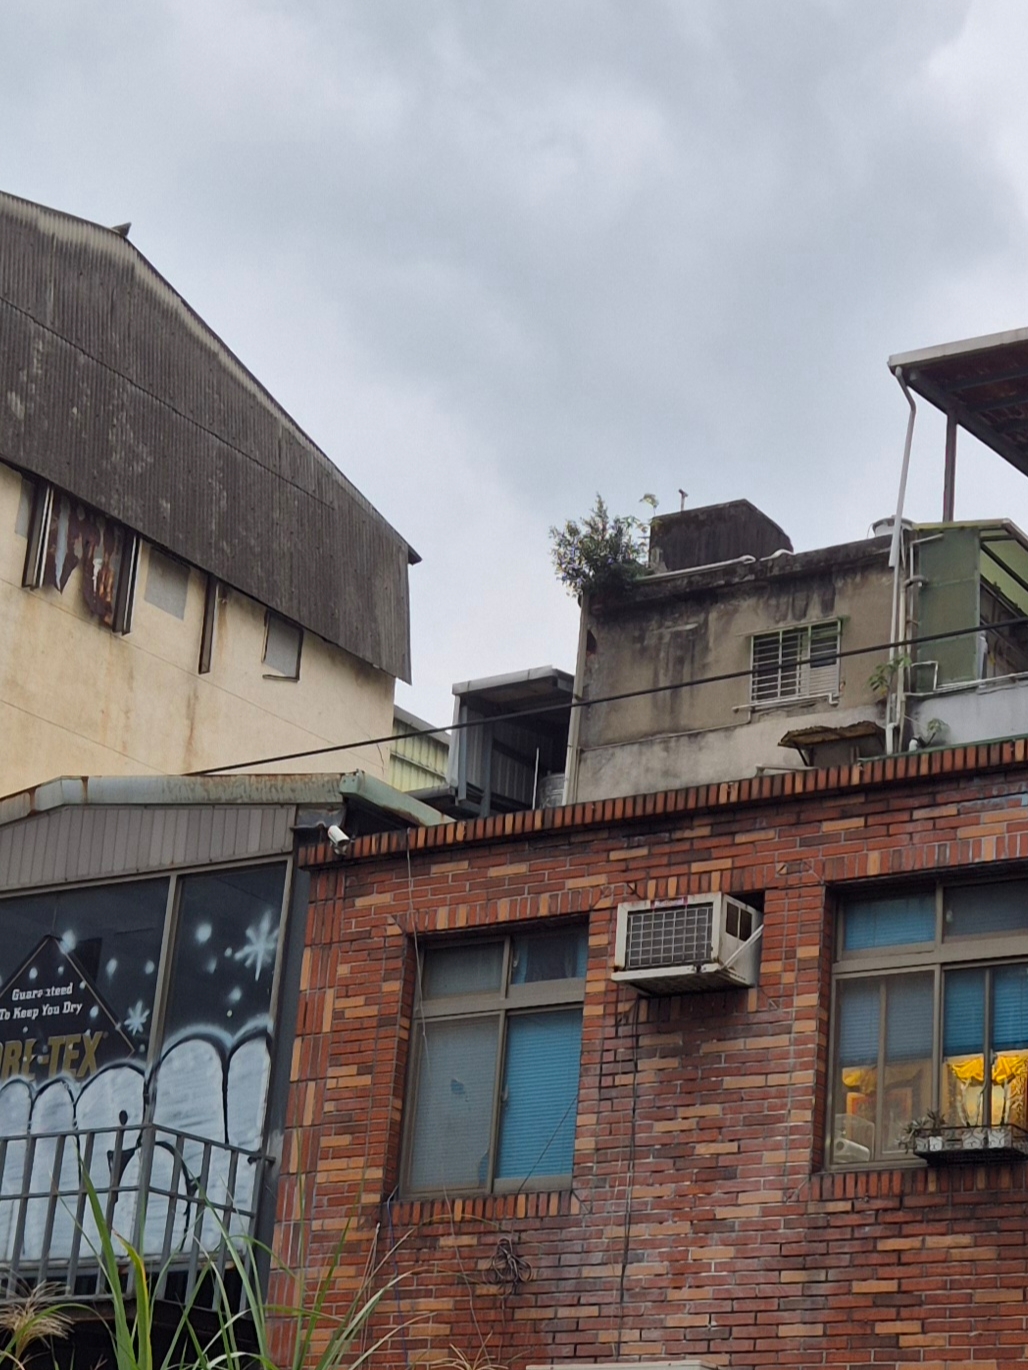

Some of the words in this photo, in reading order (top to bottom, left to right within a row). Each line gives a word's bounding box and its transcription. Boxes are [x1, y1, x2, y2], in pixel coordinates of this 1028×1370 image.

[13, 1007, 39, 1020] Keep
[42, 1003, 60, 1016] You
[62, 1001, 83, 1015] Dry
